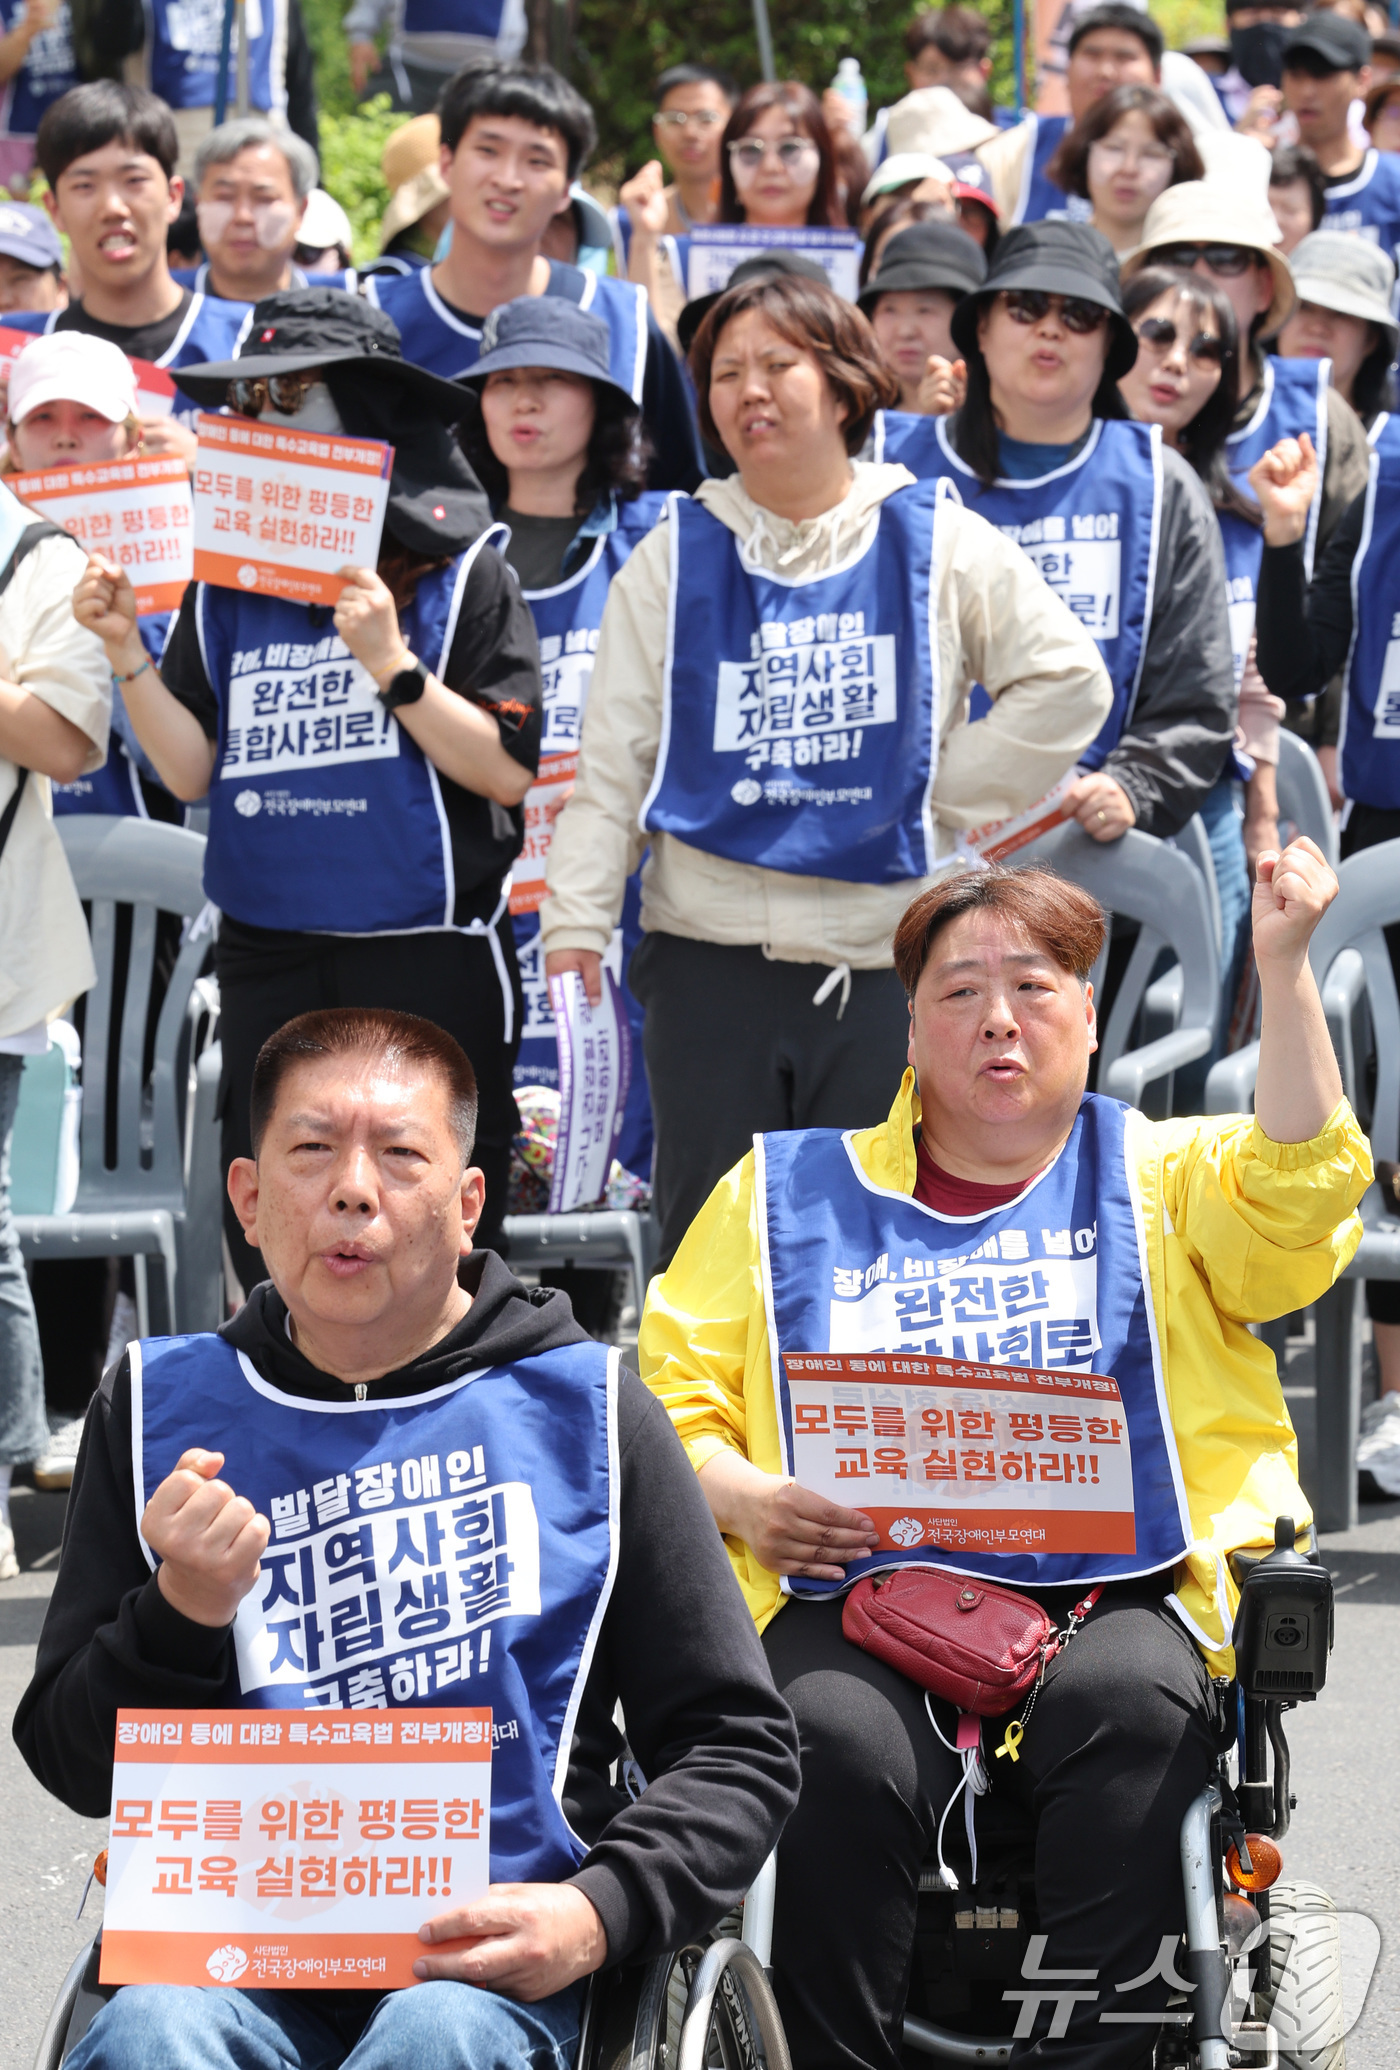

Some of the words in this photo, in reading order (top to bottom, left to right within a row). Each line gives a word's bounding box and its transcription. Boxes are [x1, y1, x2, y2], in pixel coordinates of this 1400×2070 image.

[252, 432, 275, 449] 대한
[195, 470, 254, 504] 모두를
[261, 481, 301, 511] 위한
[308, 489, 375, 523] 평등한
[122, 504, 190, 534] 평등한
[213, 506, 252, 536] 교육
[259, 514, 356, 554] 실현하라!!
[252, 668, 355, 718] 완전한
[737, 682, 878, 742] 자립생활
[744, 728, 864, 772] 구축하라!
[833, 1252, 898, 1298] 장애,
[903, 1229, 1030, 1279] 비장애를
[894, 1270, 1050, 1333] 완전한
[785, 1358, 843, 1373] 장애인
[849, 1359, 887, 1374] 등에
[893, 1360, 931, 1376] 대한
[935, 1362, 1030, 1384] 특수교육법
[1036, 1373, 1118, 1393] 전부개정!
[794, 1403, 907, 1438] 모두를
[920, 1407, 996, 1440] 위한
[1008, 1412, 1123, 1445] 평등한
[834, 1447, 909, 1480] 교육
[921, 1448, 1101, 1485] 실현하라!!
[270, 1444, 487, 1539] 발달장애인
[926, 1526, 1047, 1546] 전국장애인부모연대
[927, 1517, 958, 1527] 사단법인
[259, 1491, 508, 1613] 지역사회
[266, 1551, 515, 1674] 자립생활
[117, 1721, 184, 1746] 장애인
[189, 1721, 233, 1746] 등에
[238, 1721, 283, 1746] 대한
[288, 1721, 394, 1745] 특수교육법
[400, 1720, 491, 1744] 전부개정!
[111, 1799, 244, 1842] 모두를
[258, 1799, 345, 1842] 위한
[357, 1798, 485, 1842] 평등한
[151, 1855, 239, 1898] 교육
[254, 1855, 453, 1898] 실현하라!!
[250, 1956, 387, 1980] 전국장애인부모연대
[252, 1944, 289, 1956] 사단법인
